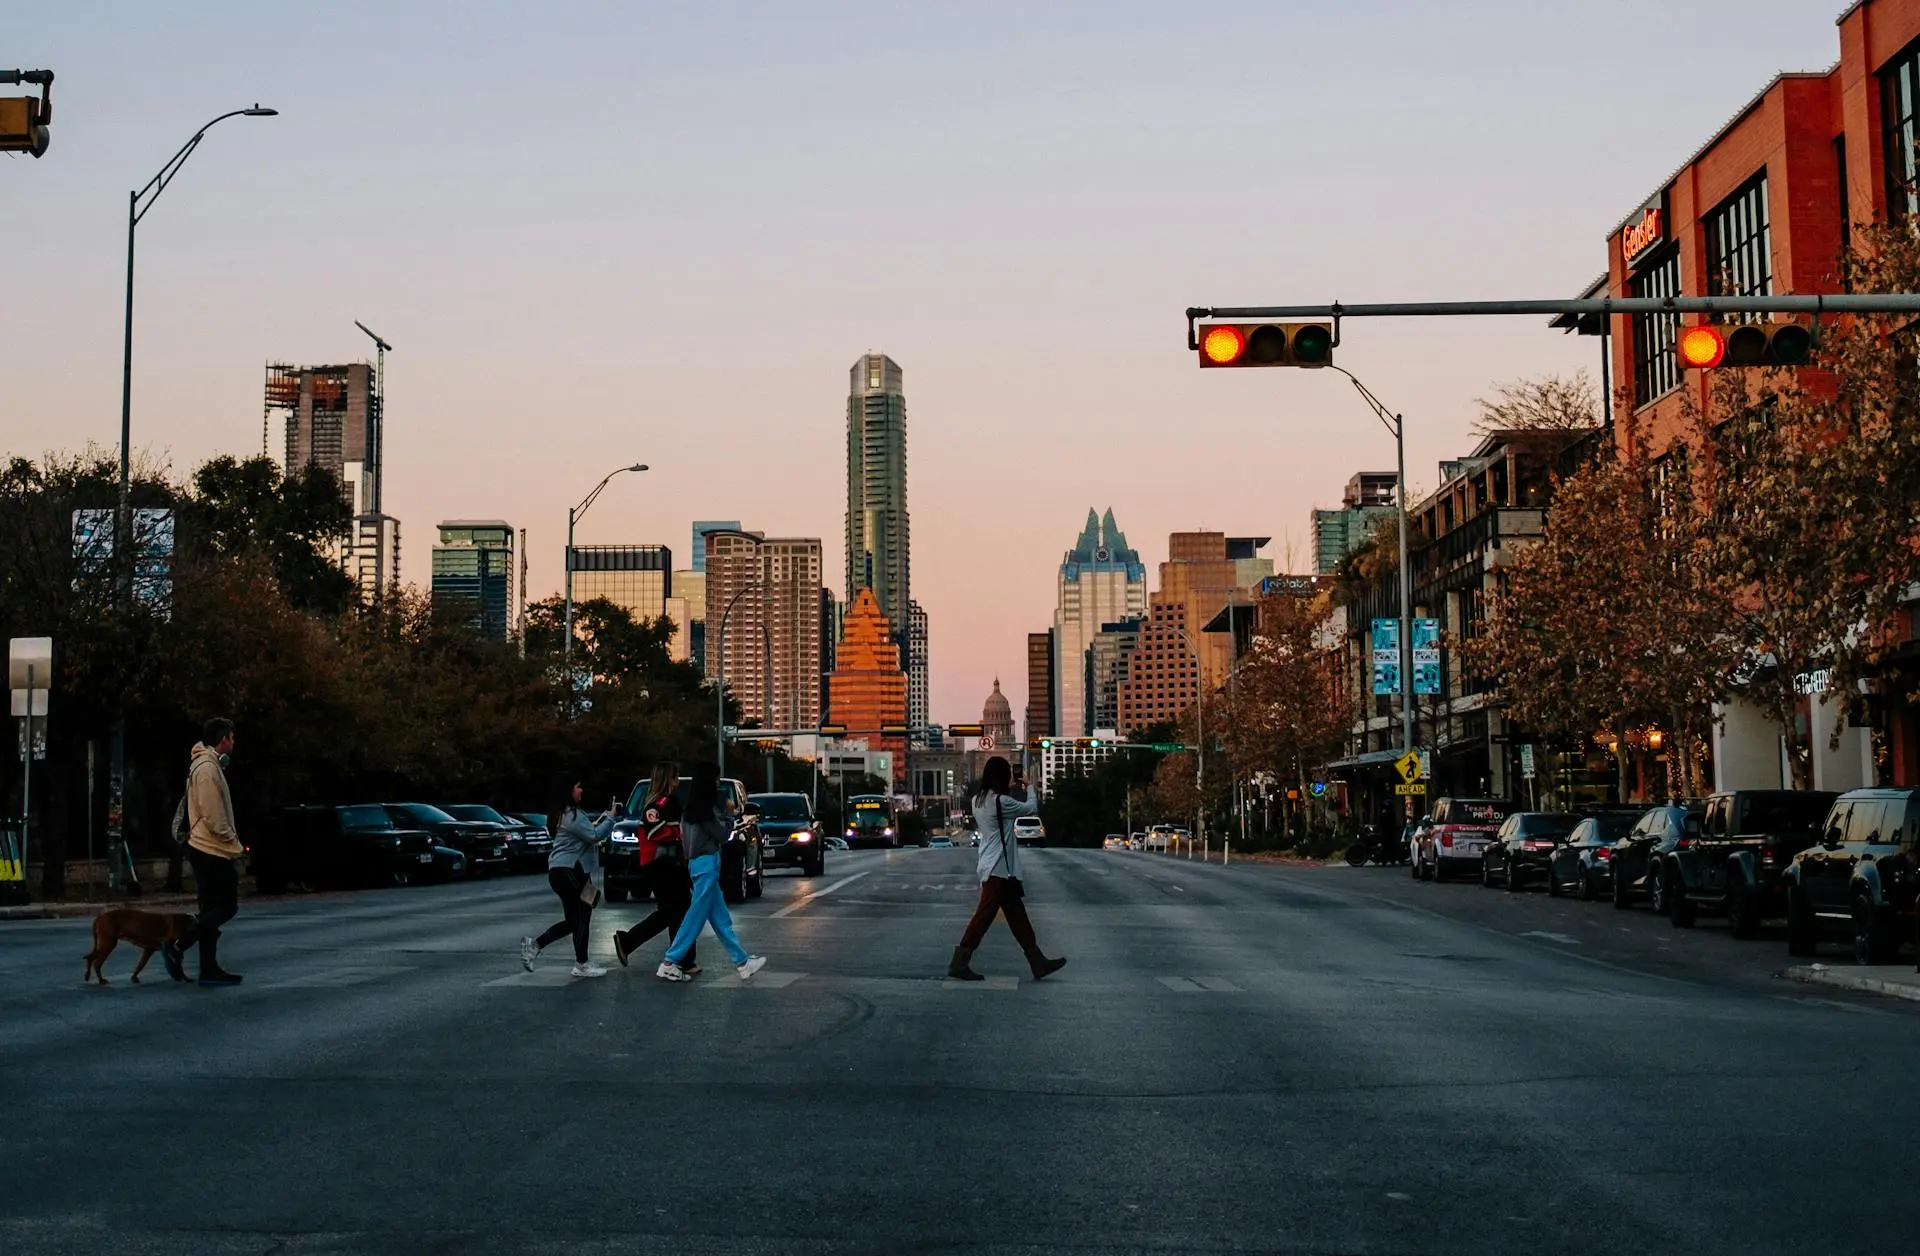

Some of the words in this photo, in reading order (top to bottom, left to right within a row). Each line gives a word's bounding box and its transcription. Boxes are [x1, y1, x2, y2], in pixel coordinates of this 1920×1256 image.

[1623, 208, 1660, 262] Gensler
[1398, 785, 1423, 793] AHEAD
[1463, 804, 1486, 812] Texas
